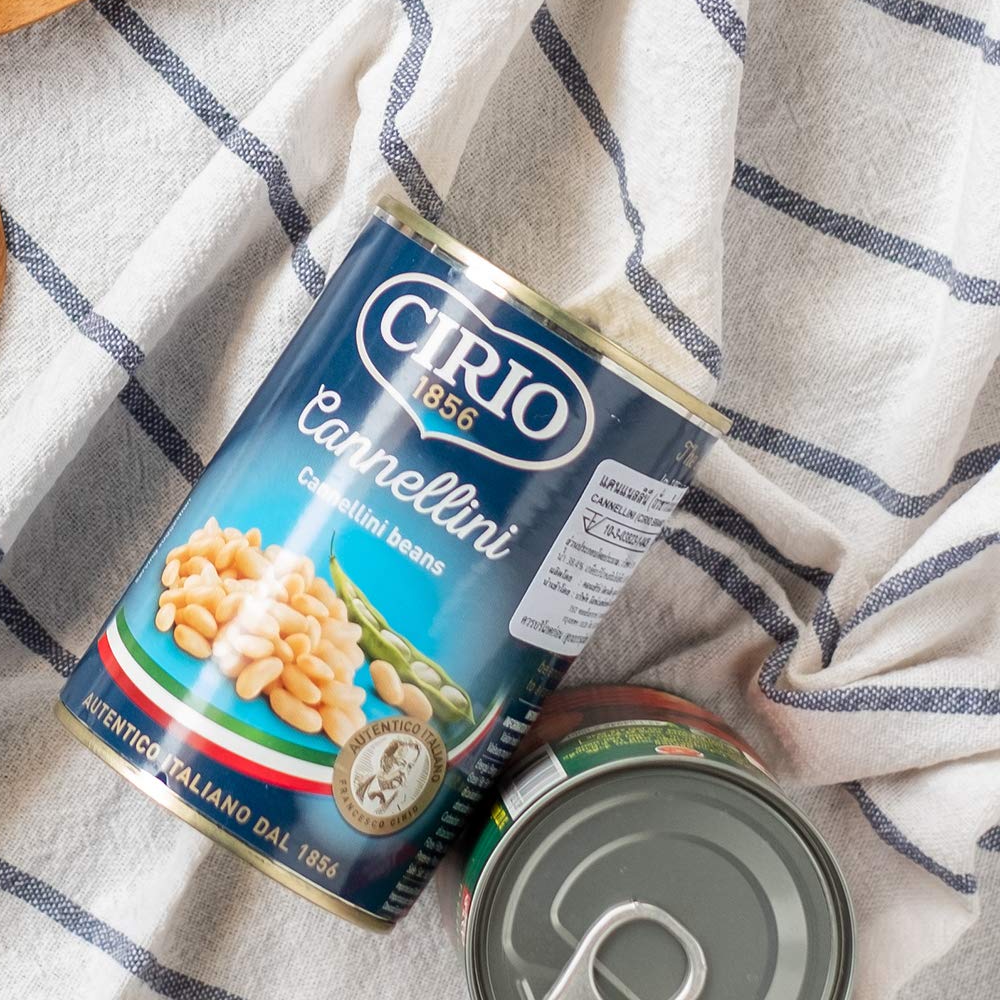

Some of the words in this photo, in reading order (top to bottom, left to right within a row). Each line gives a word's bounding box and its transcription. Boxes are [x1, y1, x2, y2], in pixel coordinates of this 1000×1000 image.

[379, 292, 569, 442] CIRIO
[410, 374, 481, 432] 1856
[298, 382, 518, 561] Cannellini
[590, 493, 636, 521] CANNELLINI
[298, 466, 389, 539] Cannellini
[387, 525, 447, 577] beans
[81, 691, 161, 759] AUTENTICO
[160, 752, 252, 827] ITALIANO
[253, 813, 291, 854] DAL
[298, 841, 340, 881] 1856
[348, 718, 422, 754] AUTENTICO
[420, 727, 443, 784] ITALIANO
[338, 779, 385, 829] FRANCESCO
[389, 805, 420, 827] CIRIO
